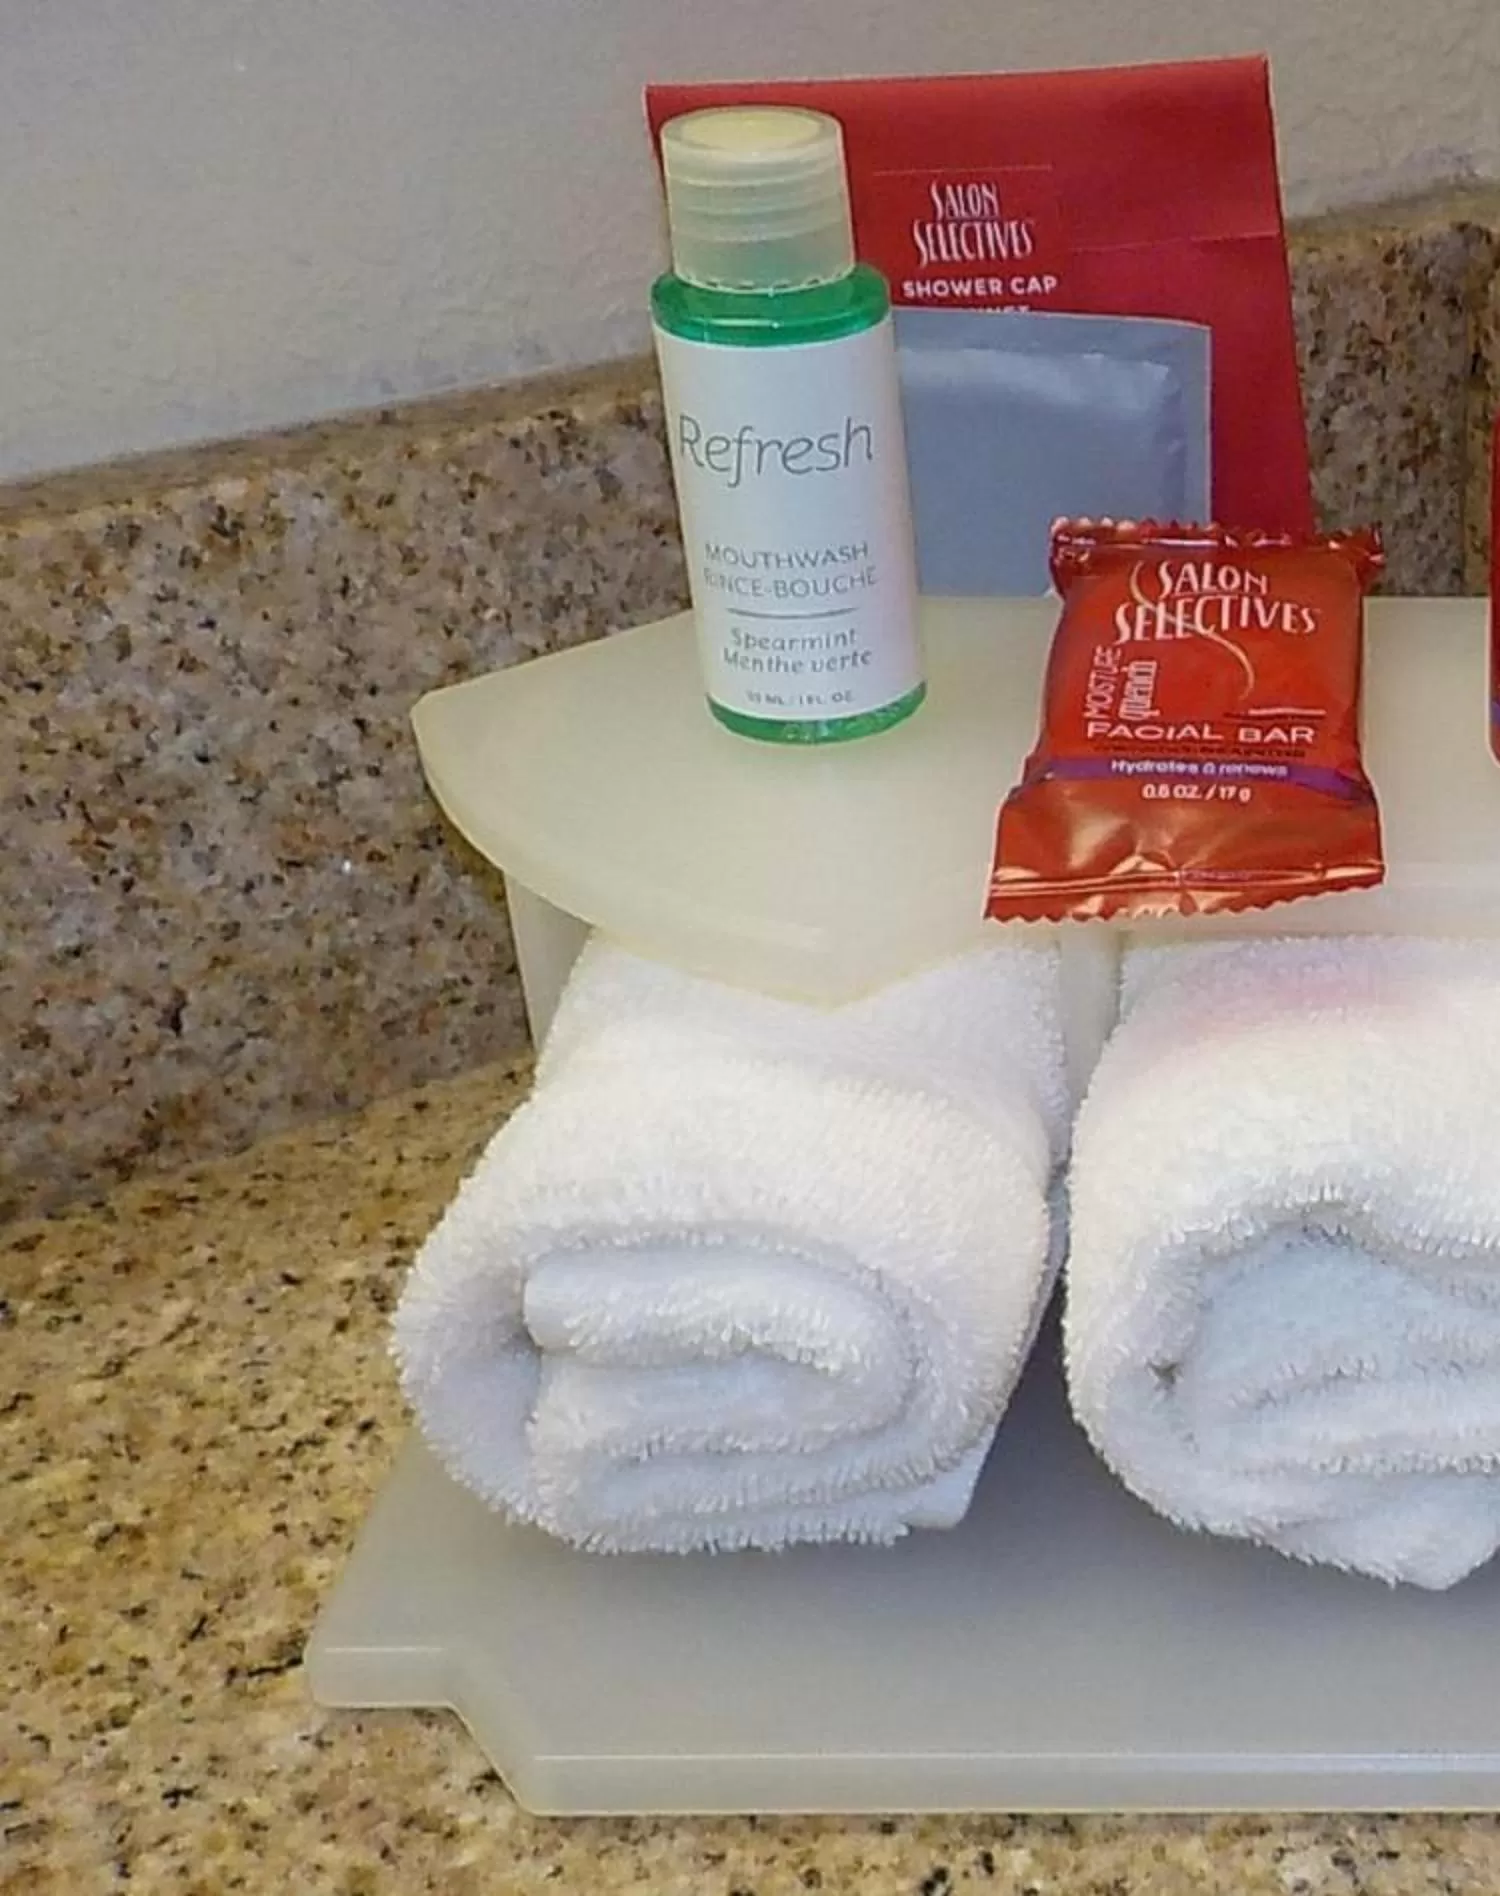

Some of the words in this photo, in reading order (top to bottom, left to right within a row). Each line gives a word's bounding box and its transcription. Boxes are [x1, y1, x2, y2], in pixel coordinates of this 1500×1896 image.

[931, 180, 1000, 220] SALON
[913, 219, 1034, 268] SELECTIVES
[903, 278, 1003, 298] SHOWER
[1010, 275, 1058, 296] CAP
[678, 414, 874, 489] Refresh
[704, 541, 870, 569] MOUTHWASH
[1157, 560, 1268, 599] SALON
[1113, 594, 1317, 645] SELECTIVES
[730, 626, 856, 652] Spearmint
[723, 647, 804, 673] Menthe
[810, 650, 872, 673] verte
[1087, 721, 1224, 741] FACIAL
[1238, 725, 1316, 744] BAR
[1111, 758, 1199, 776] Hydrates
[1219, 763, 1289, 777] renews
[1239, 787, 1252, 803] g
